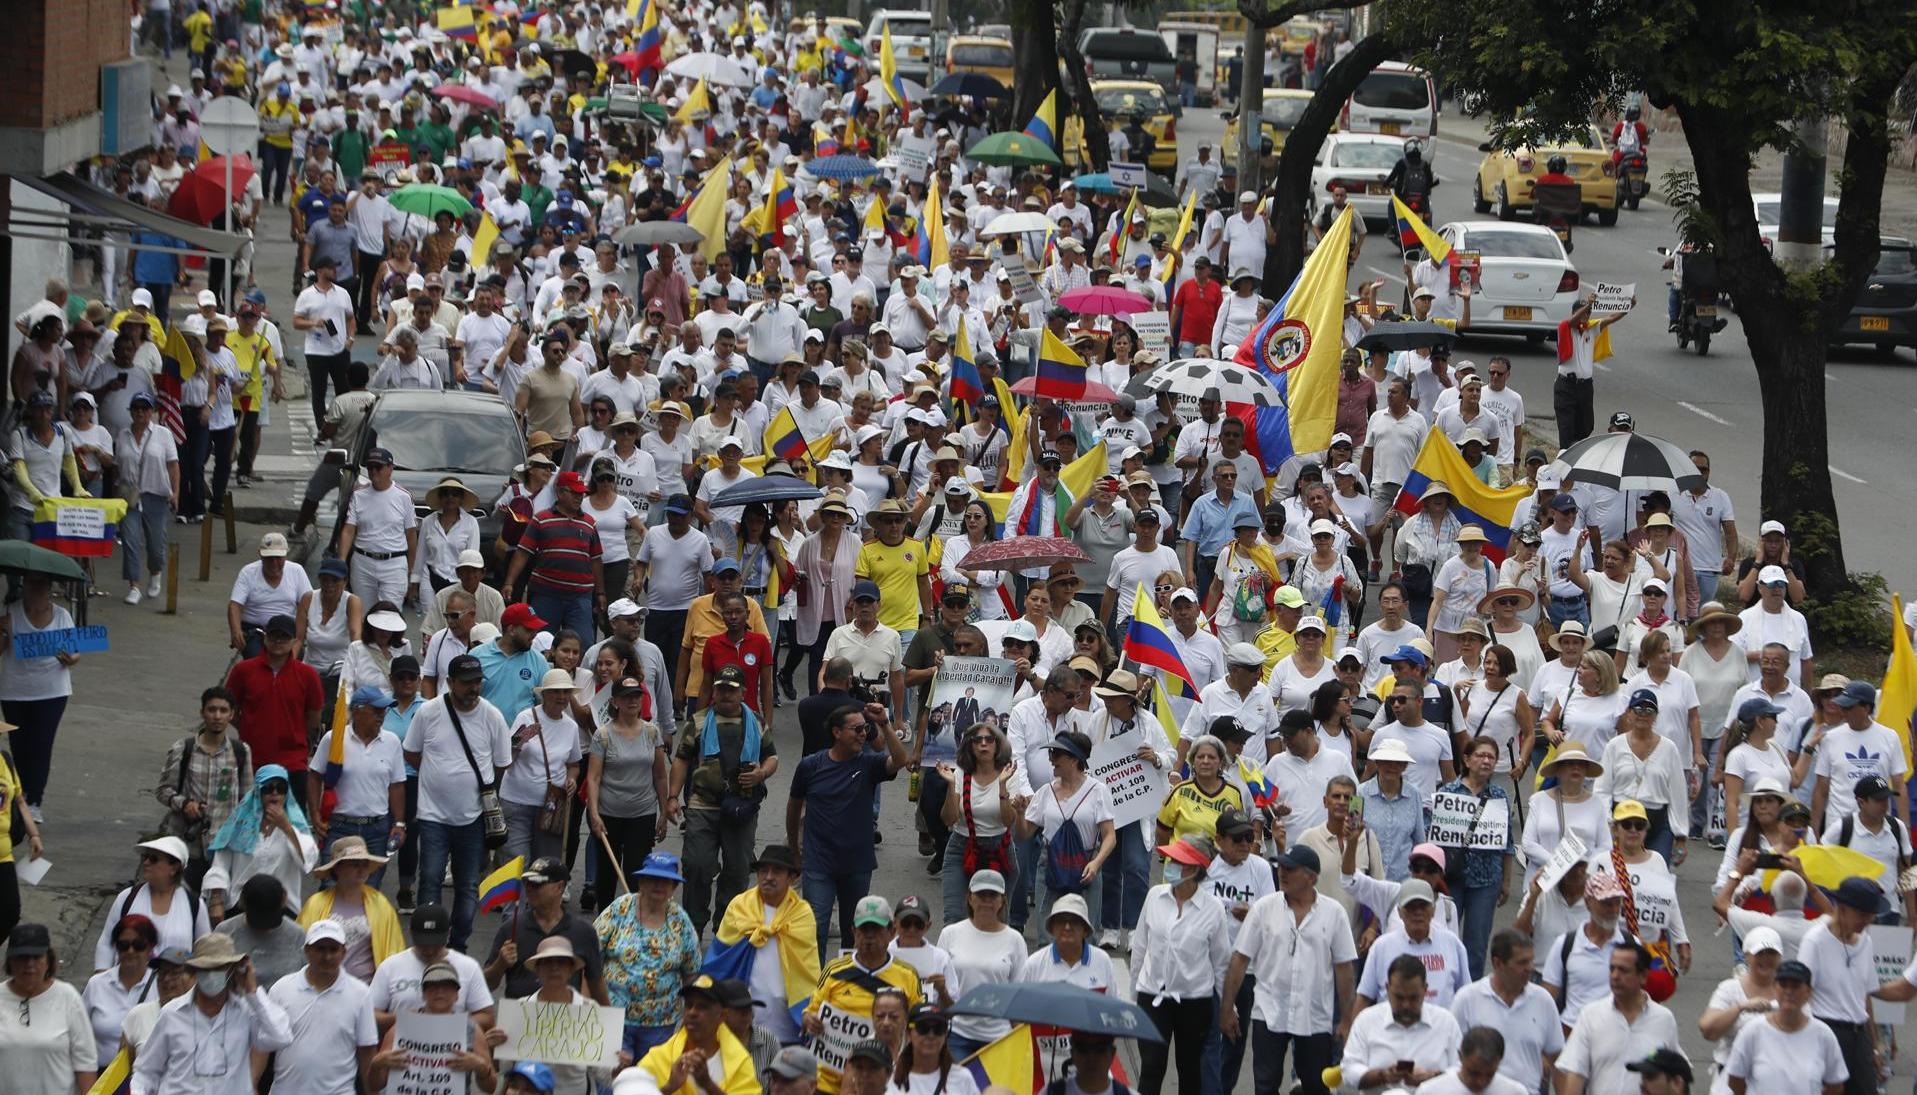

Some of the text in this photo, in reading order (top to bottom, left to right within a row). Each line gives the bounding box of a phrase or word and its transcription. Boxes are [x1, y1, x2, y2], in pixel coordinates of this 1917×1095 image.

[1597, 283, 1622, 294] Petro
[1593, 300, 1630, 311] Renuncia
[1064, 402, 1108, 413] Renuncia
[1105, 427, 1135, 440] NIKE
[616, 474, 634, 487] tro
[952, 662, 969, 671] Que
[1094, 753, 1138, 776] CONGRES
[1105, 763, 1143, 785] ACTIVAR
[1111, 774, 1146, 795] Art. 109
[1112, 784, 1153, 807] de la C.P.
[1433, 794, 1477, 815] Petro
[821, 1004, 870, 1038] Petro
[398, 1039, 462, 1054] CONGRESO
[403, 1070, 451, 1084] Art. 109
[397, 1085, 412, 1095] de
